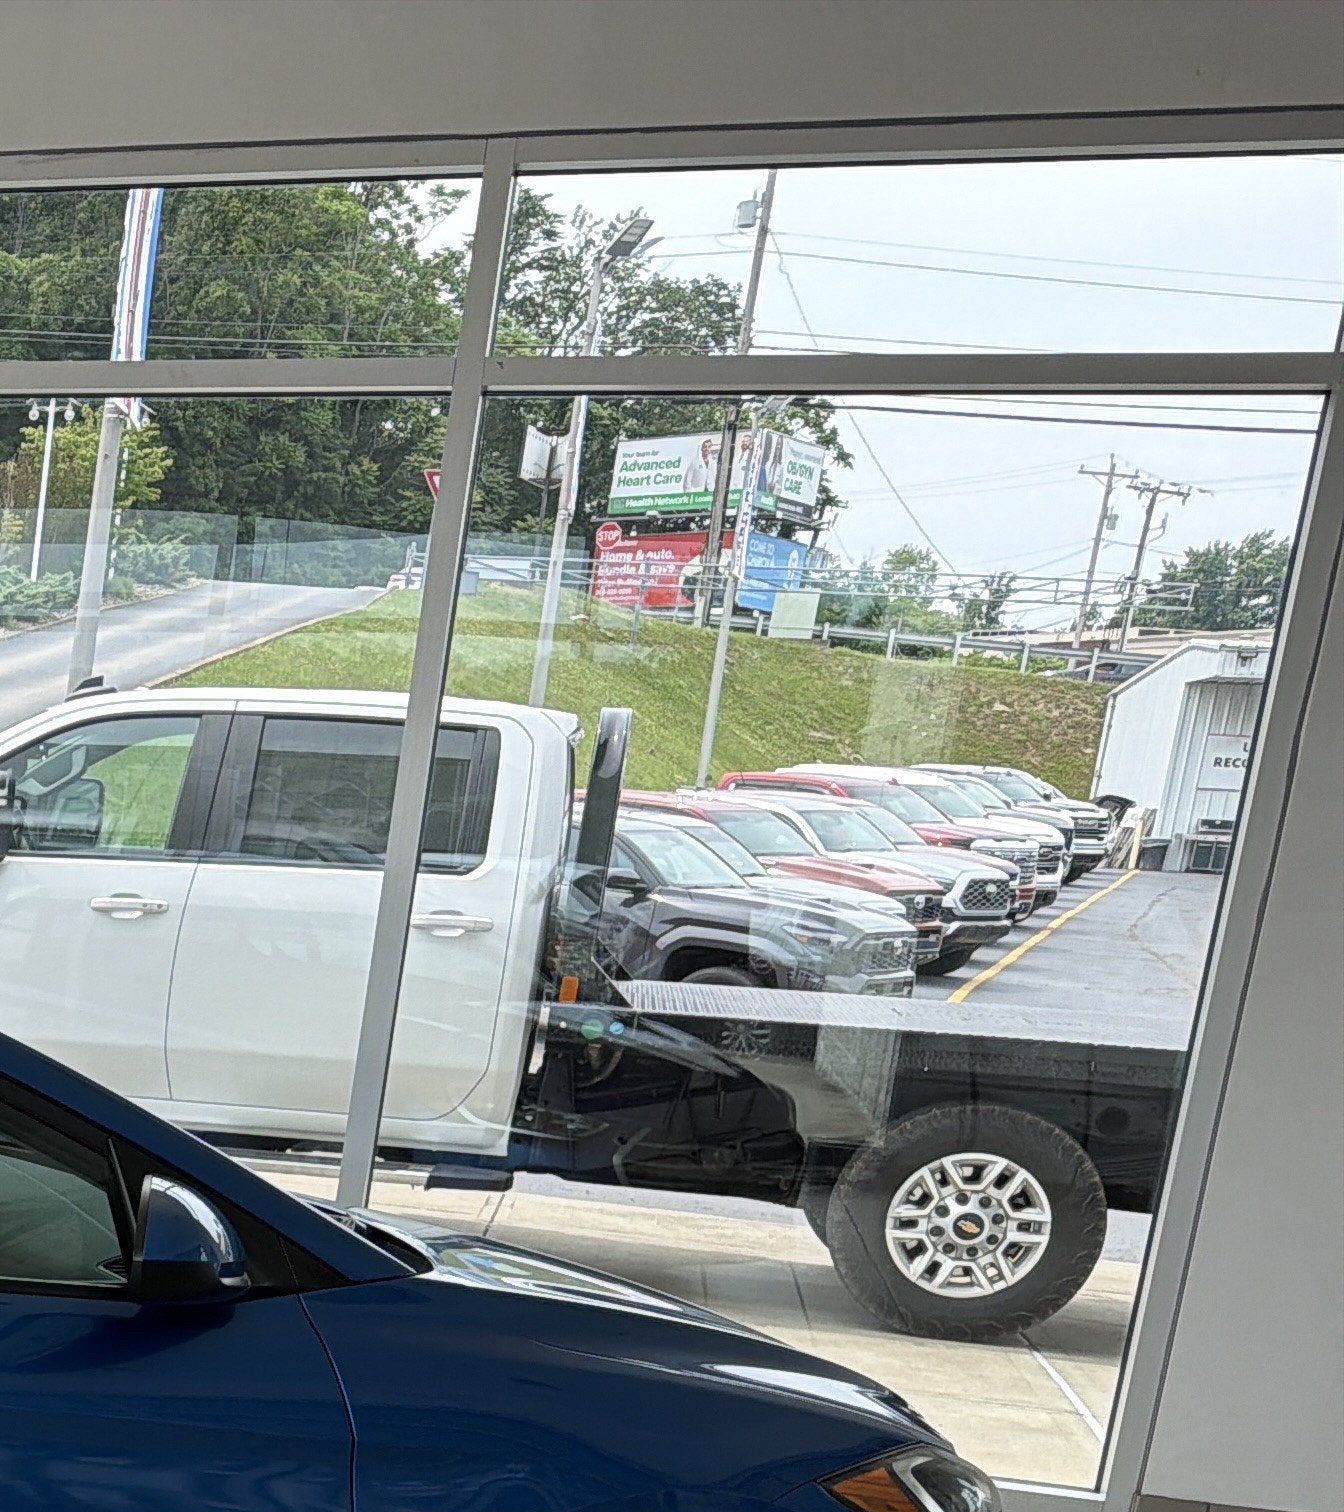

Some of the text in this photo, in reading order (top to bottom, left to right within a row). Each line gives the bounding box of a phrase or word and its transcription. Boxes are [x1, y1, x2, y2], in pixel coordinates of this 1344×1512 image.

[619, 456, 682, 473] Advanced
[617, 472, 683, 488] Heart Care
[625, 497, 653, 508] Health
[654, 495, 689, 506] Network
[598, 530, 620, 541] STOP
[600, 551, 633, 562] Home
[636, 549, 645, 560] &
